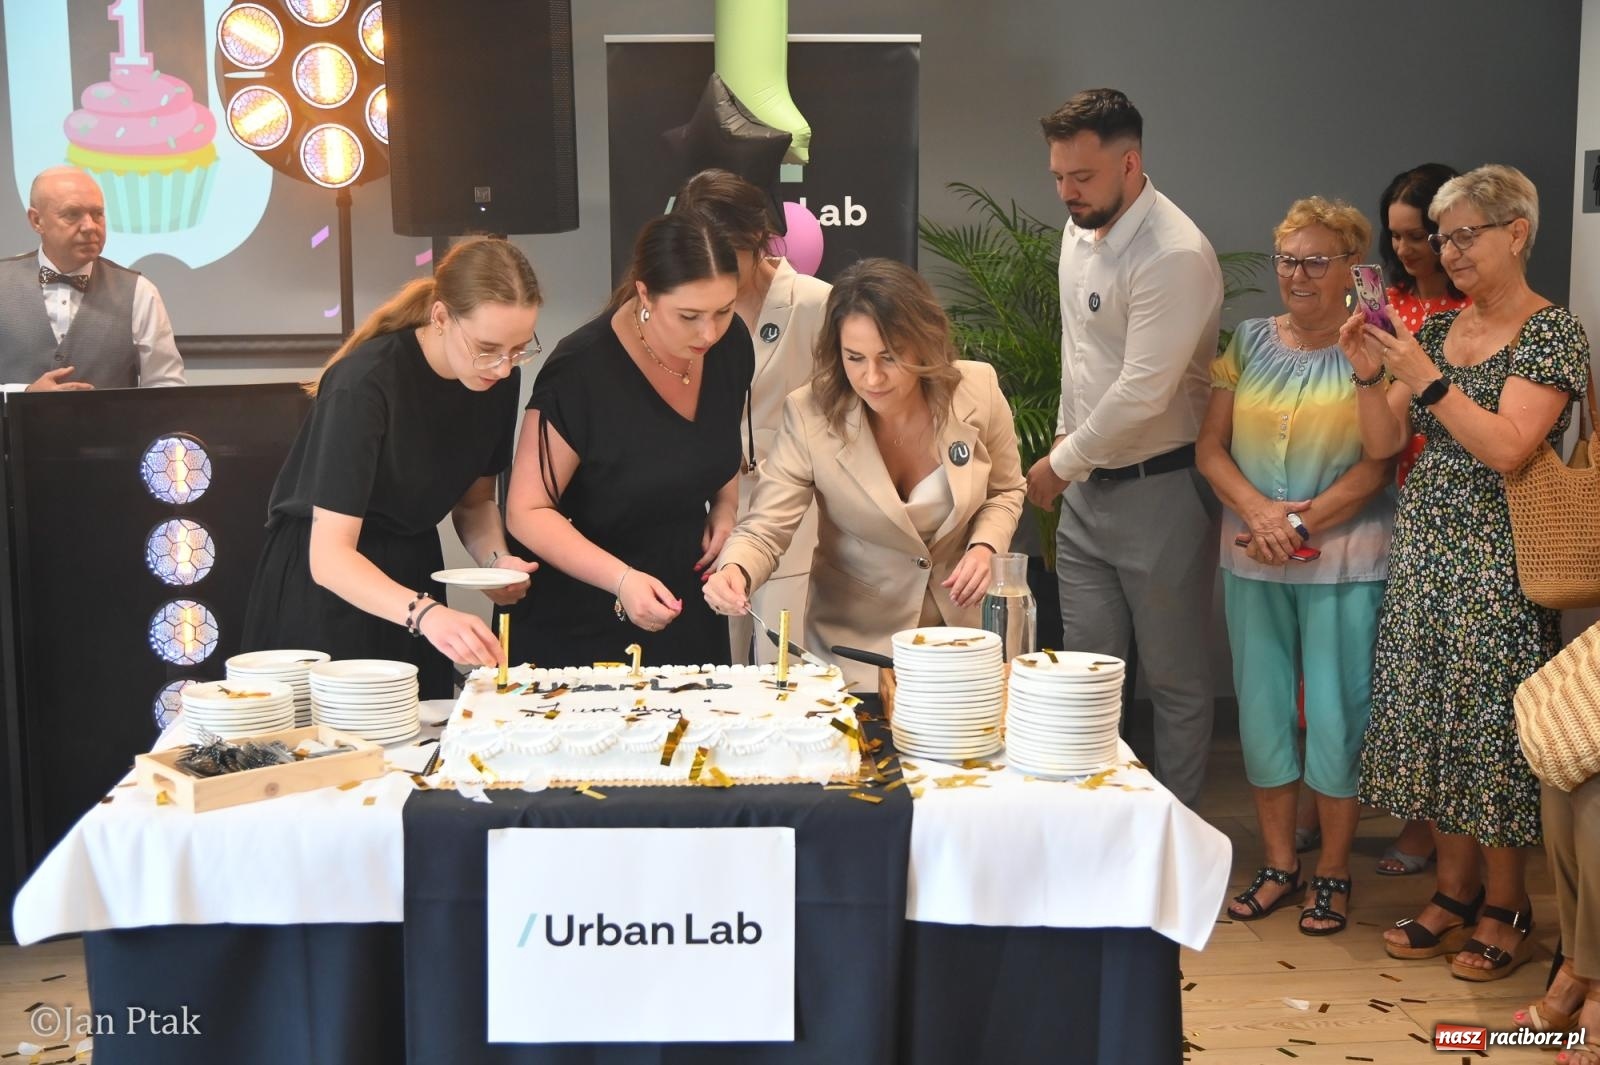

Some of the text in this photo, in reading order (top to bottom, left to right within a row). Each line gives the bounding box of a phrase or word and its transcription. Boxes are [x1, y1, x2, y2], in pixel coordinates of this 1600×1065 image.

[799, 193, 868, 227] ab
[650, 678, 733, 693] Lb
[685, 911, 763, 945] Lab
